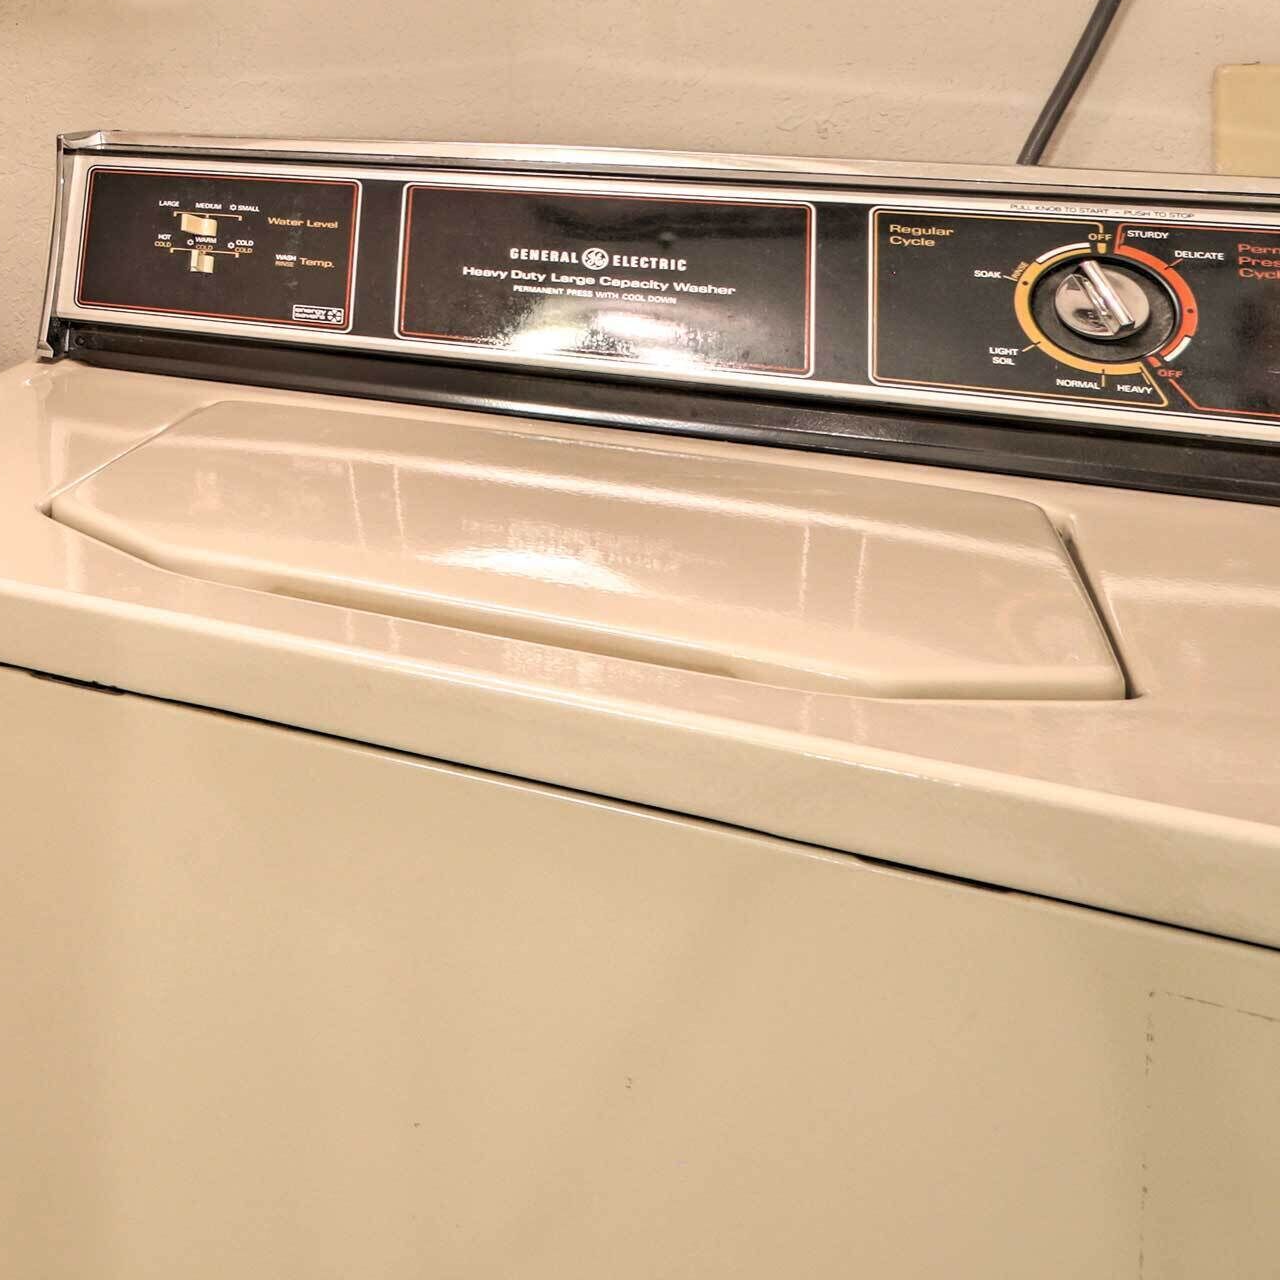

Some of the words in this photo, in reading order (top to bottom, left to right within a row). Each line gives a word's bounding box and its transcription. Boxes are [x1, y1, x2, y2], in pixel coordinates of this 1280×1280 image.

[195, 202, 222, 210] MEDIUM
[237, 204, 260, 212] SMALL
[267, 217, 304, 226] Water
[307, 220, 338, 228] Level
[890, 224, 954, 237] Regular
[1127, 230, 1170, 240] STURDY
[195, 236, 217, 244] WARM
[890, 236, 935, 247] Cycle
[1088, 233, 1113, 241] OFF
[236, 239, 254, 247] COLD
[510, 248, 578, 264] GENERAL
[613, 255, 687, 271] ELECTRIC
[1174, 250, 1225, 261] DELICATE
[299, 257, 335, 268] Temp.
[974, 270, 1001, 279] SOAK
[463, 266, 508, 280] Heavy
[511, 269, 546, 282] Duty
[551, 273, 595, 287] Large
[600, 276, 669, 291] Capacity
[674, 282, 736, 295] Washer
[513, 285, 564, 295] PERMANENT
[566, 289, 592, 298] PRESS
[596, 291, 619, 300] WITH
[622, 293, 645, 302] COOL
[648, 295, 677, 304] DOWN
[294, 307, 327, 316] energy
[989, 346, 1019, 356] LIGHT
[992, 357, 1015, 366] SOIL
[1158, 370, 1183, 378] OFF
[1056, 378, 1101, 390] NORMAL
[1117, 384, 1153, 394] HEAVY
